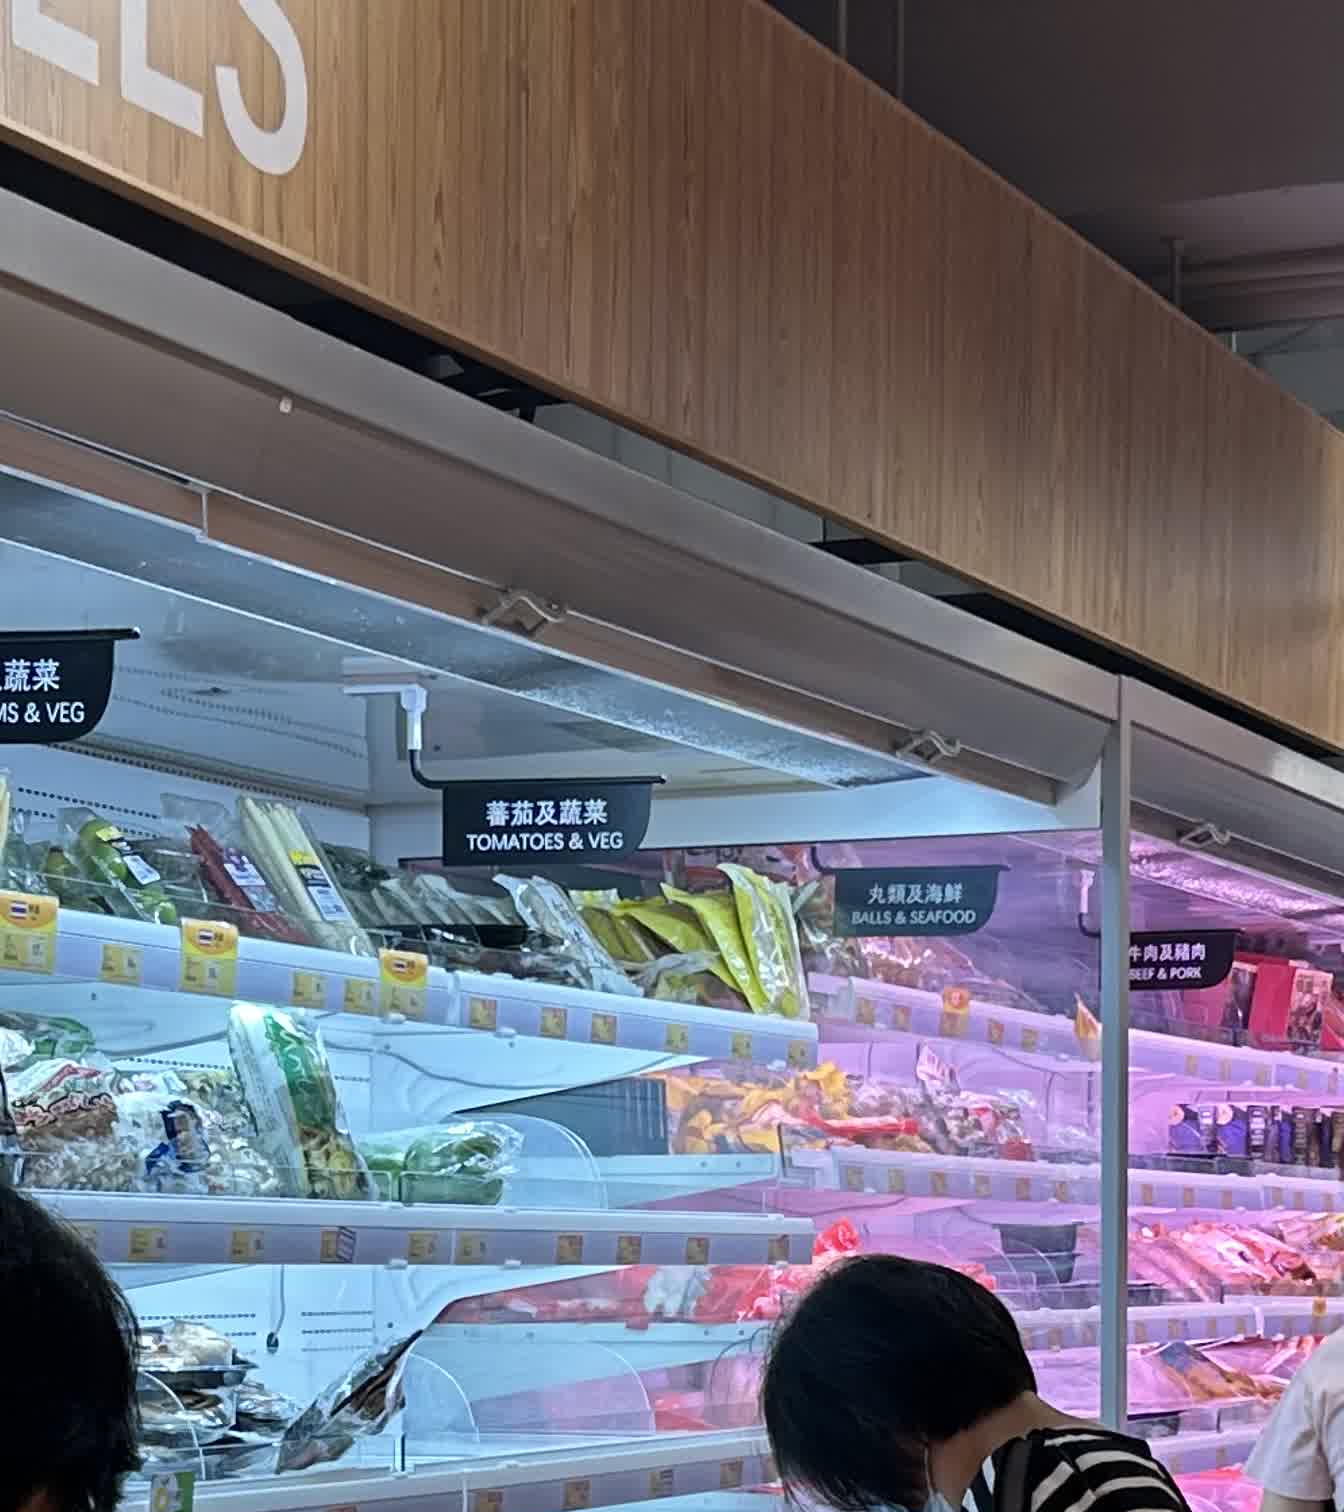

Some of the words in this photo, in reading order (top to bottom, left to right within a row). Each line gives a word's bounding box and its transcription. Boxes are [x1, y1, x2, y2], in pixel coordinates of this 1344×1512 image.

[24, 702, 40, 723] &
[45, 701, 85, 723] VEG
[486, 799, 608, 827] 蕃茄及蔬菜
[466, 832, 564, 851] TOMATOES
[568, 832, 584, 850] &
[588, 831, 624, 849] VEG
[867, 883, 963, 905] 丸類及海鮮
[851, 910, 892, 925] BALLS
[894, 910, 907, 925] &
[909, 909, 977, 925] SEAFOOD
[1156, 967, 1168, 980] &
[1169, 966, 1203, 980] PORK
